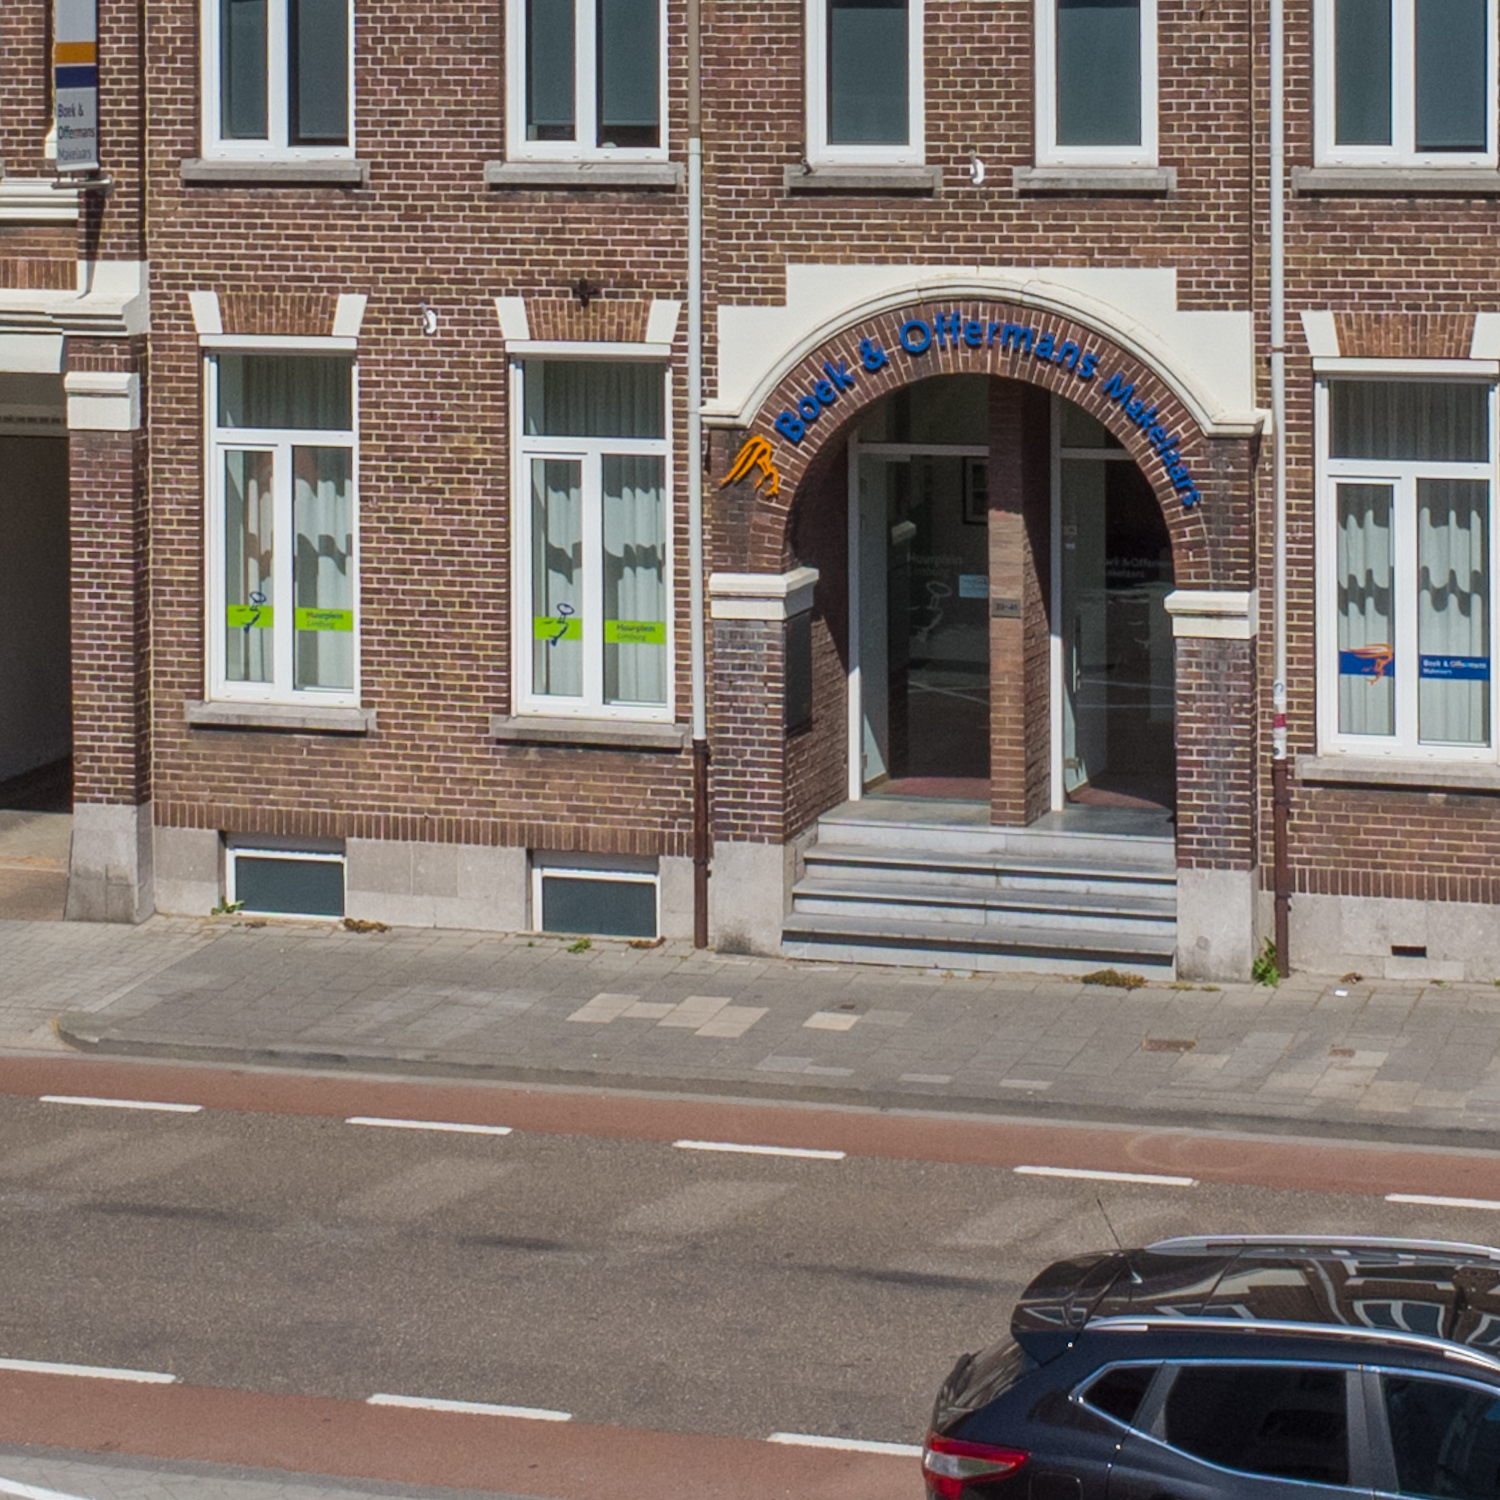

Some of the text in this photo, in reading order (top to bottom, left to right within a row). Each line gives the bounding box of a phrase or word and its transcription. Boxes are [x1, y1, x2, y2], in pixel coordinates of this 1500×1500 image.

[58, 103, 76, 117] Boek
[58, 126, 95, 139] Offermans
[775, 311, 1200, 506] Boek & Offermans Makelaars
